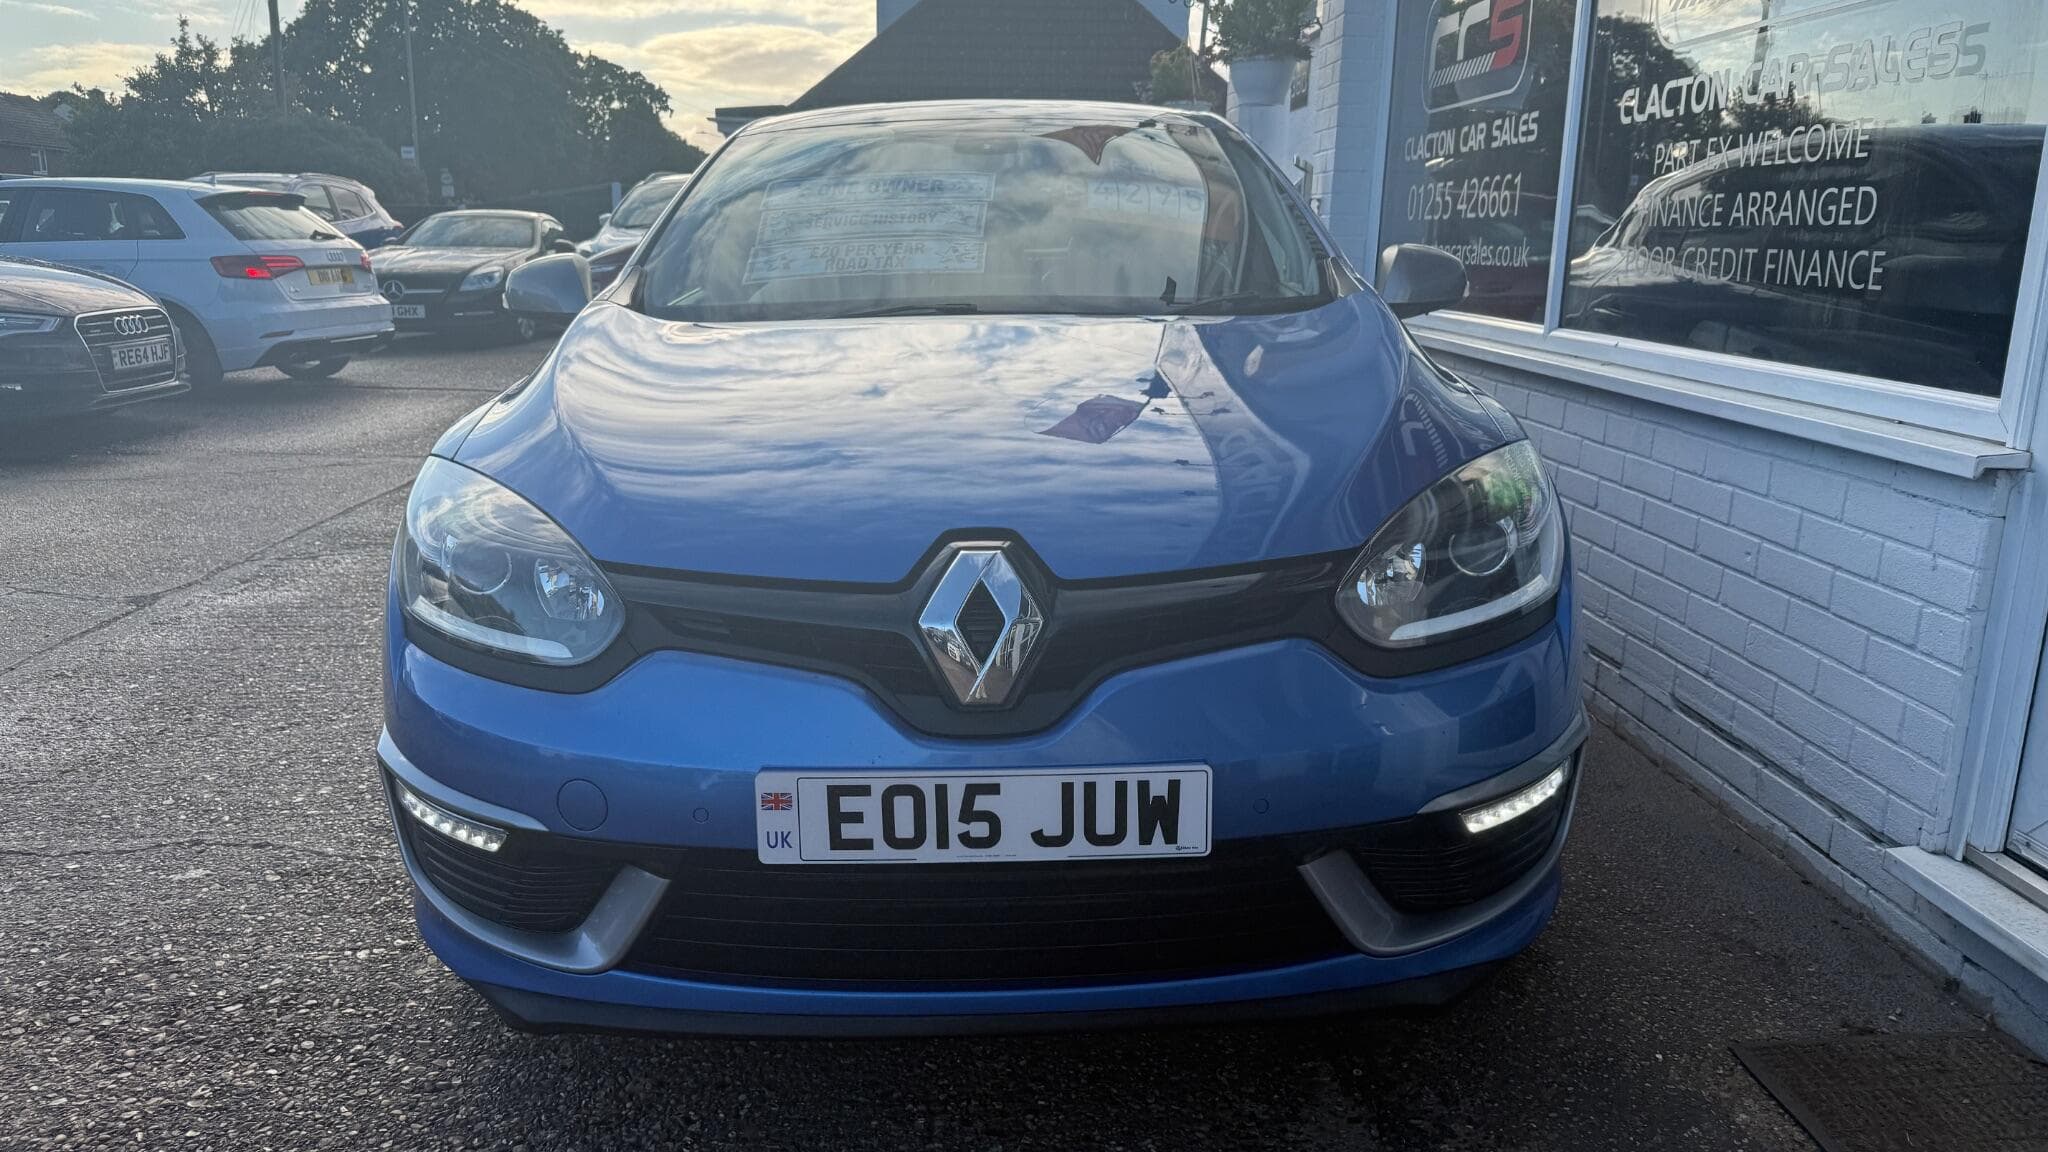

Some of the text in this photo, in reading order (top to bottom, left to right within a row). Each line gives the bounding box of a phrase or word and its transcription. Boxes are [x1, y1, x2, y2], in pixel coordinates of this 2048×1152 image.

[1619, 69, 1731, 125] CLACTON
[1744, 53, 1810, 104] CAR
[1404, 110, 1540, 162] CLACTON CAR SALES
[1653, 139, 1702, 175] PART
[1739, 121, 1871, 168] WELCOME
[868, 177, 944, 194] OWNER
[1407, 172, 1523, 221] 01255 426661
[806, 210, 937, 231] SERVICE HISTORY
[1728, 186, 1879, 227] ARRANGED
[824, 255, 906, 271] ROAD TAX
[844, 243, 877, 257] PER
[880, 241, 926, 256] YEAR
[1681, 246, 1759, 284] CREDIT
[1763, 248, 1887, 292] FINANCE
[119, 343, 169, 368] RE64 HJF
[826, 779, 1182, 852] EO15 JUW
[766, 830, 792, 850] UK
